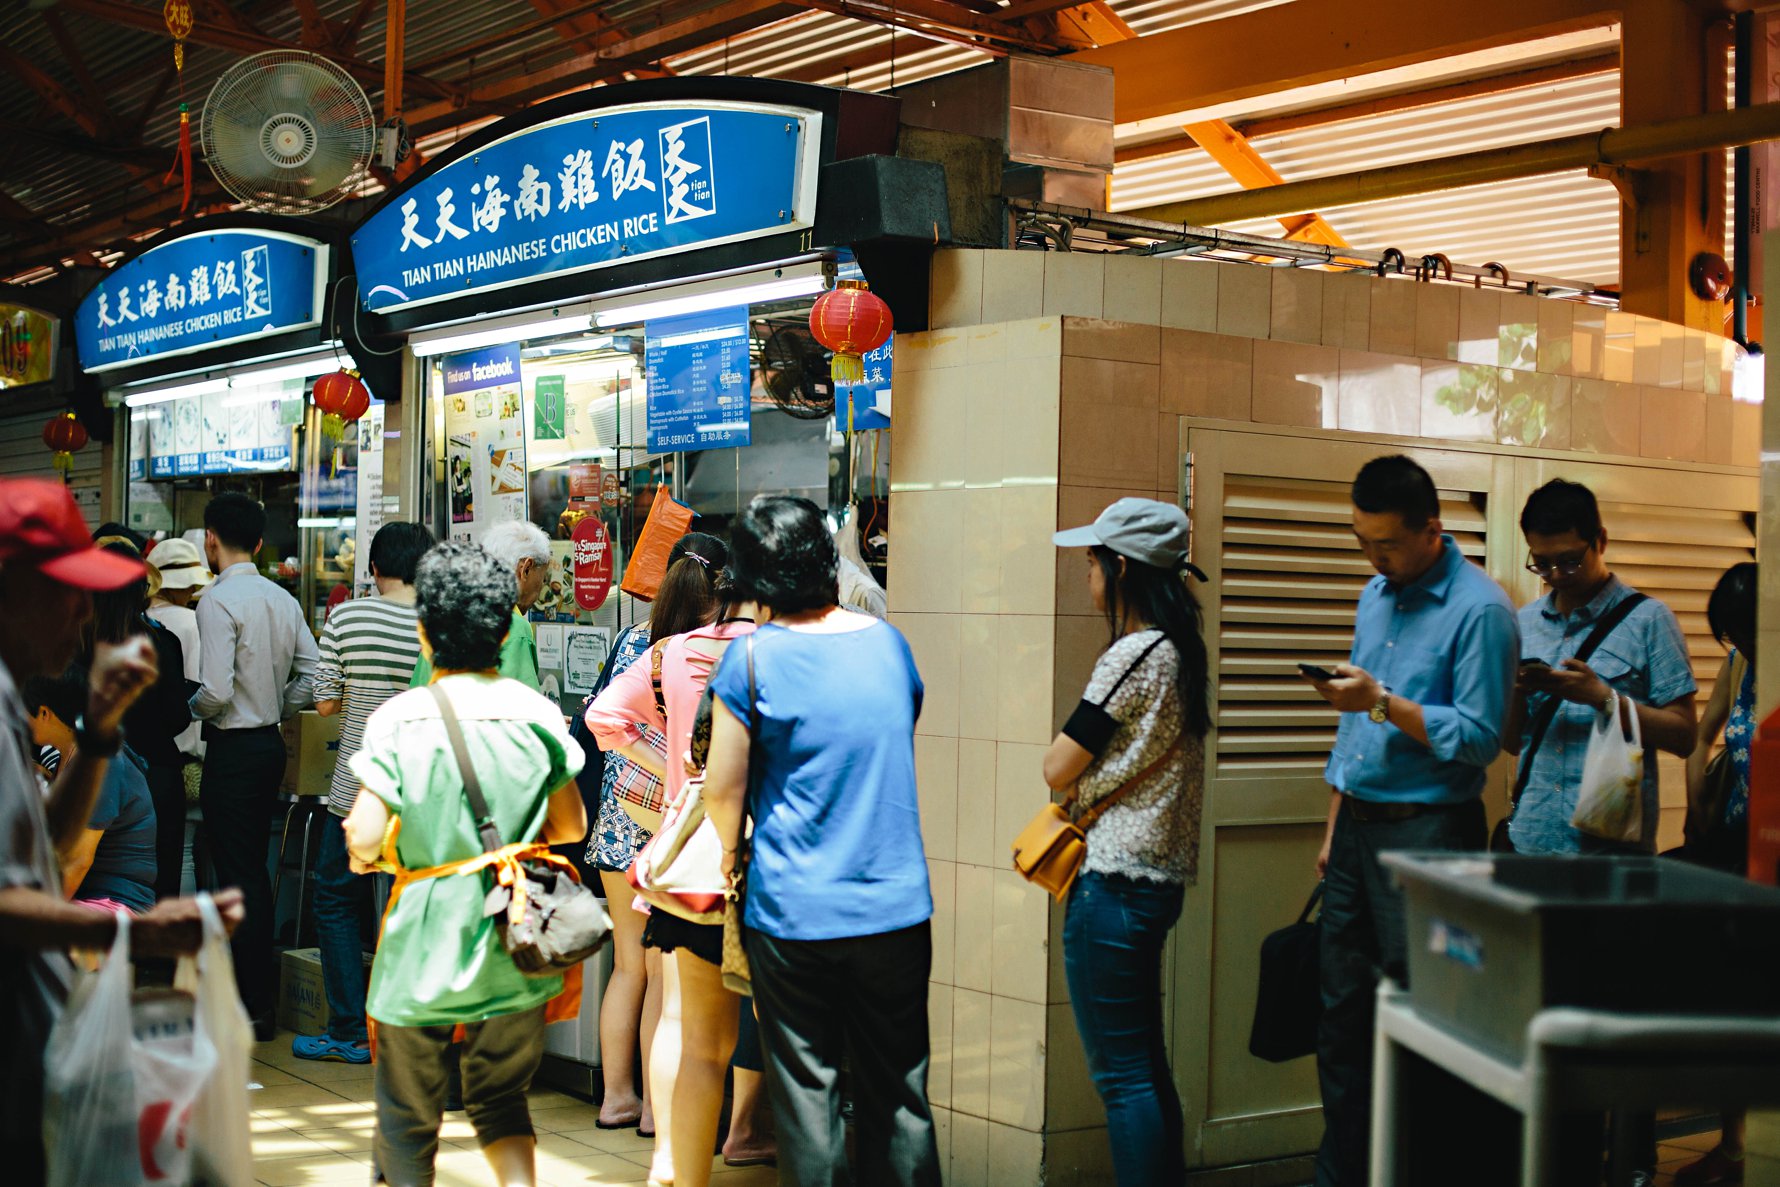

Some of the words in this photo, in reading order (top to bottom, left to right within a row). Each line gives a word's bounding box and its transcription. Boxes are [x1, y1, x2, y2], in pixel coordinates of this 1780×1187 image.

[400, 138, 656, 252] 天天海南雞飯
[691, 180, 707, 191] tian
[694, 190, 710, 201] tian
[402, 265, 431, 287] TIAN
[433, 258, 464, 280] TIAN
[467, 238, 547, 273] HAINANESE
[551, 221, 620, 253] CHICKEN
[623, 212, 659, 239] RICE
[800, 230, 813, 252] 11
[97, 260, 241, 328] 天天海南雞飯
[98, 337, 115, 352] TIAN
[117, 331, 137, 347] TIAN
[137, 320, 184, 345] HAINANESE
[184, 313, 222, 334] CHICKEN
[223, 307, 243, 323] RICE
[472, 356, 515, 382] facebook
[544, 393, 556, 424] B
[657, 434, 695, 446] SELF-SERVICE
[700, 430, 731, 442] 自助服务
